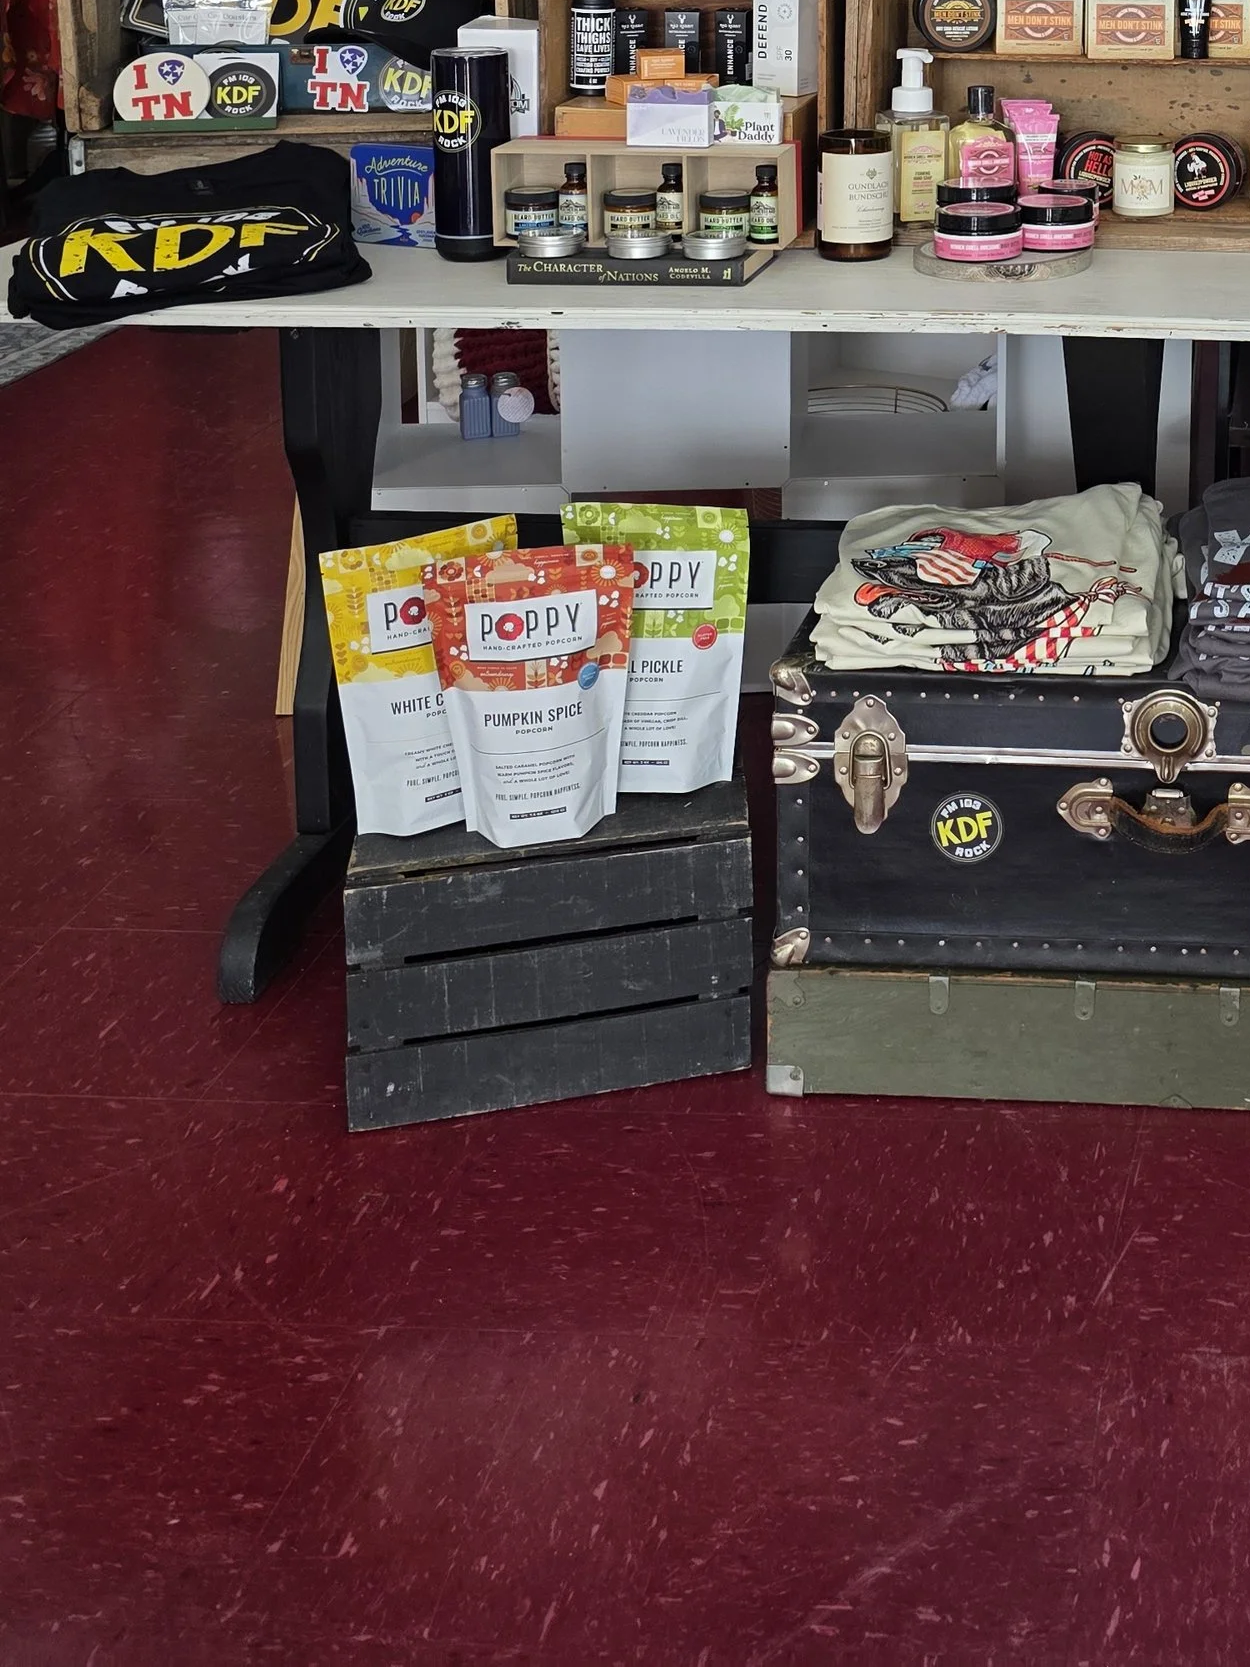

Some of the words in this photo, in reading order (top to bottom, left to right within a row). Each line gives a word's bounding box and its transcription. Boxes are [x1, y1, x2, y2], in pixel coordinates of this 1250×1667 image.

[576, 17, 610, 30] THICK
[1008, 16, 1025, 25] MEN
[1050, 16, 1072, 25] STINK
[1100, 19, 1116, 30] MEN
[1118, 19, 1139, 30] DON'T
[1142, 19, 1163, 30] STINK
[1220, 19, 1241, 30] STINK
[577, 32, 610, 44] THIGHS
[758, 4, 768, 59] DEFEND
[577, 45, 592, 53] SAVE
[594, 45, 610, 53] LIVES
[314, 48, 328, 74] I
[133, 63, 149, 90] I
[223, 75, 237, 85] FM
[238, 74, 256, 84] 103
[216, 85, 261, 105] KDF
[309, 82, 366, 110] TN
[448, 94, 466, 108] 103
[132, 92, 194, 121] TN
[224, 104, 253, 114] ROCK
[433, 110, 474, 134] KDF
[745, 122, 774, 132] Plant
[438, 135, 466, 148] ROCK
[738, 131, 775, 143] Daddy
[365, 155, 428, 173] Adventure
[1088, 151, 1101, 163] HOT
[1103, 154, 1112, 163] AS
[1086, 161, 1108, 176] HELL
[373, 177, 420, 210] TRIVIA
[517, 264, 531, 272] The
[533, 261, 603, 273] CHARACTER
[606, 271, 658, 282] NATIONS
[483, 642, 542, 651] HAND-CRAFTED
[546, 636, 583, 646] POPCORN
[642, 660, 683, 673] PICKLE
[391, 697, 431, 715] WHITE
[484, 710, 543, 728] PUMPKIN
[548, 701, 583, 722] SPICE
[516, 726, 553, 735] POPCORN
[941, 801, 958, 818] FM
[960, 799, 981, 810] 103
[937, 811, 992, 847] KDF
[955, 840, 991, 857] ROCK
